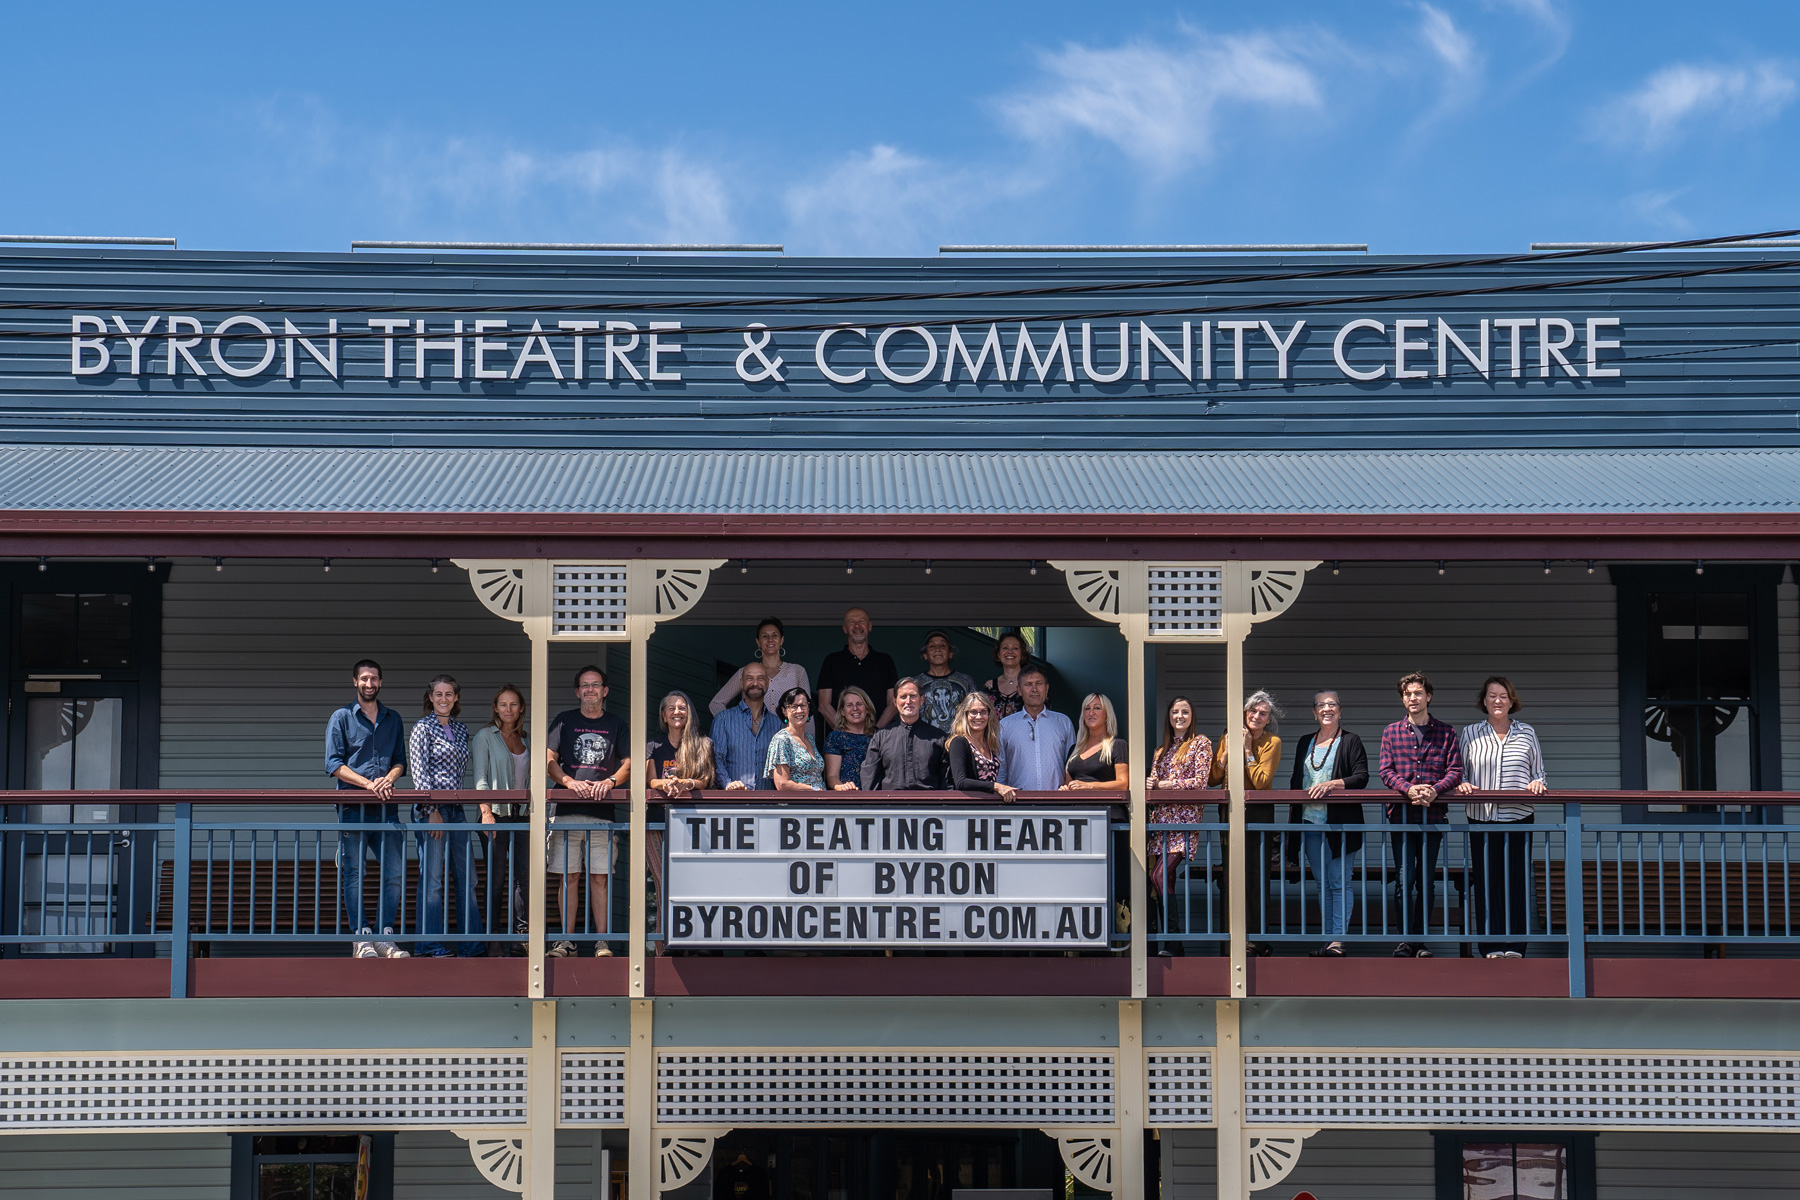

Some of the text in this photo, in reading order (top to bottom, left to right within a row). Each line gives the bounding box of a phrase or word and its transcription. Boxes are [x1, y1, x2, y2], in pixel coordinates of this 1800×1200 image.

[71, 314, 1621, 385] BYRON THEATRE & COMMUNITY CENTRE
[686, 817, 1089, 851] THE BEATING HEART
[789, 861, 995, 895] OF BYRON
[672, 905, 1103, 940] BYRONCENTRE.COM.AU
